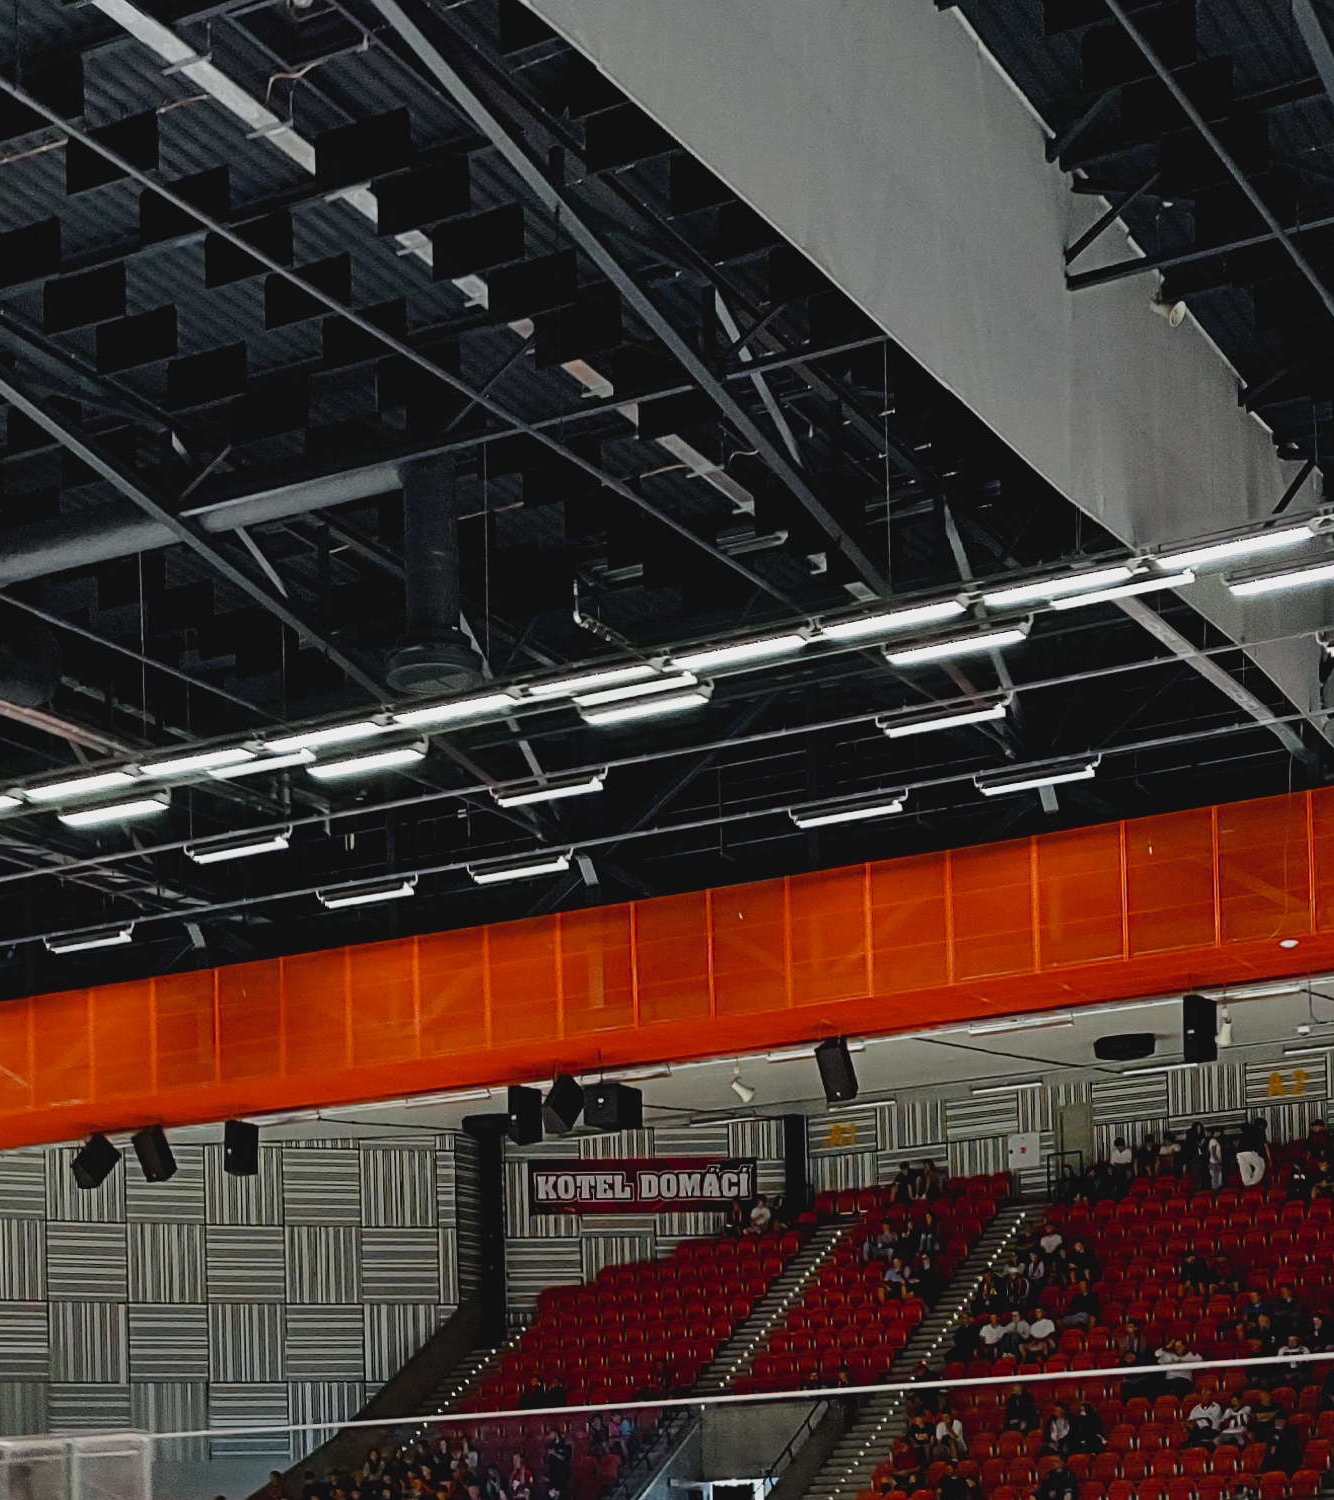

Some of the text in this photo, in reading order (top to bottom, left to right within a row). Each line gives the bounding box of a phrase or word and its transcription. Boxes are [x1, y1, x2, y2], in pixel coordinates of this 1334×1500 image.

[1267, 1069, 1308, 1098] A2
[826, 1121, 857, 1148] A1
[536, 1166, 752, 1200] KOTEL DOMÁCÍ
